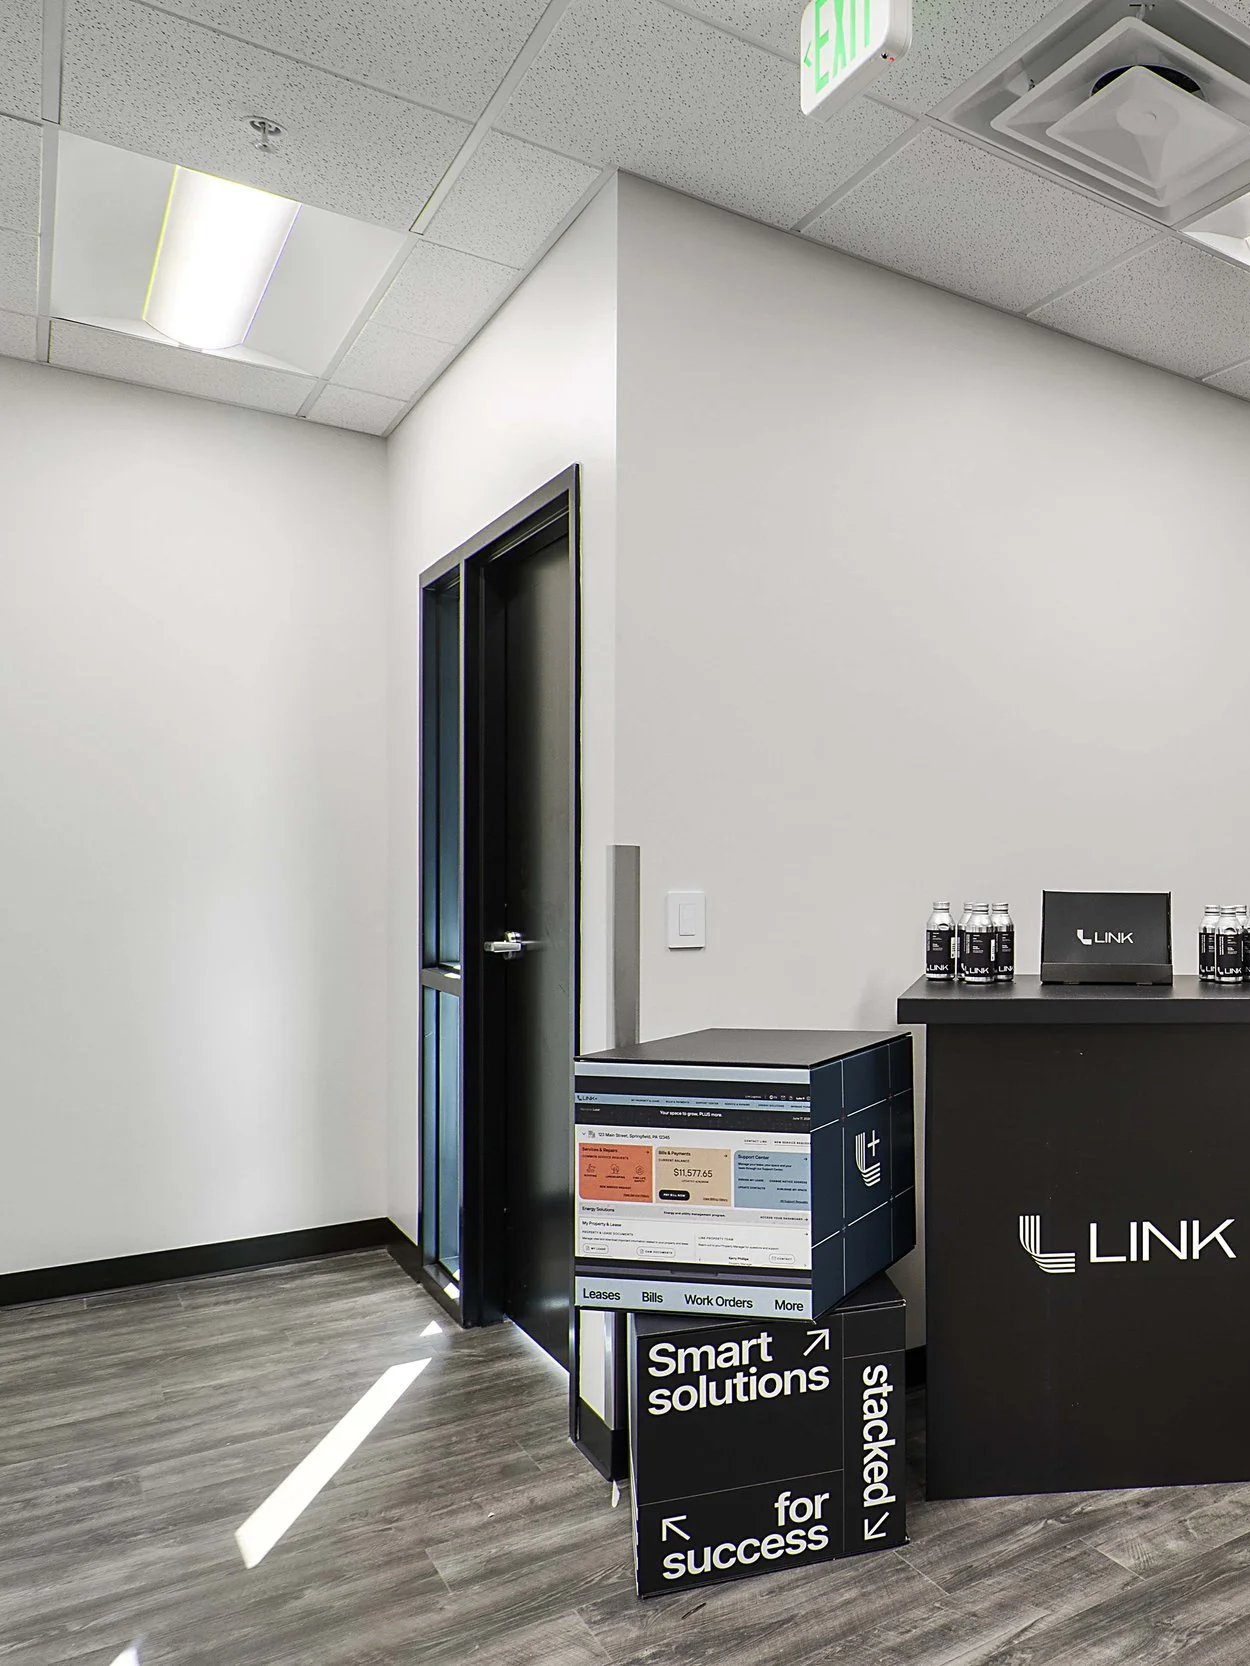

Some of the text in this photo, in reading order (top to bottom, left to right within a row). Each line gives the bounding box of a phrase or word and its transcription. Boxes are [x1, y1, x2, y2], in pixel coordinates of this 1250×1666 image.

[1094, 931, 1134, 944] LINK
[673, 1168, 713, 1178] $11,577.65
[1089, 1218, 1237, 1263] LINK
[582, 1287, 621, 1301] Leases
[641, 1292, 663, 1304] Bills
[684, 1294, 753, 1309] Work Orders
[774, 1299, 804, 1312] More
[648, 1331, 773, 1378] Smart
[648, 1364, 830, 1416] solutions
[862, 1364, 896, 1508] stacked
[773, 1490, 830, 1527] for
[662, 1524, 829, 1581] success
